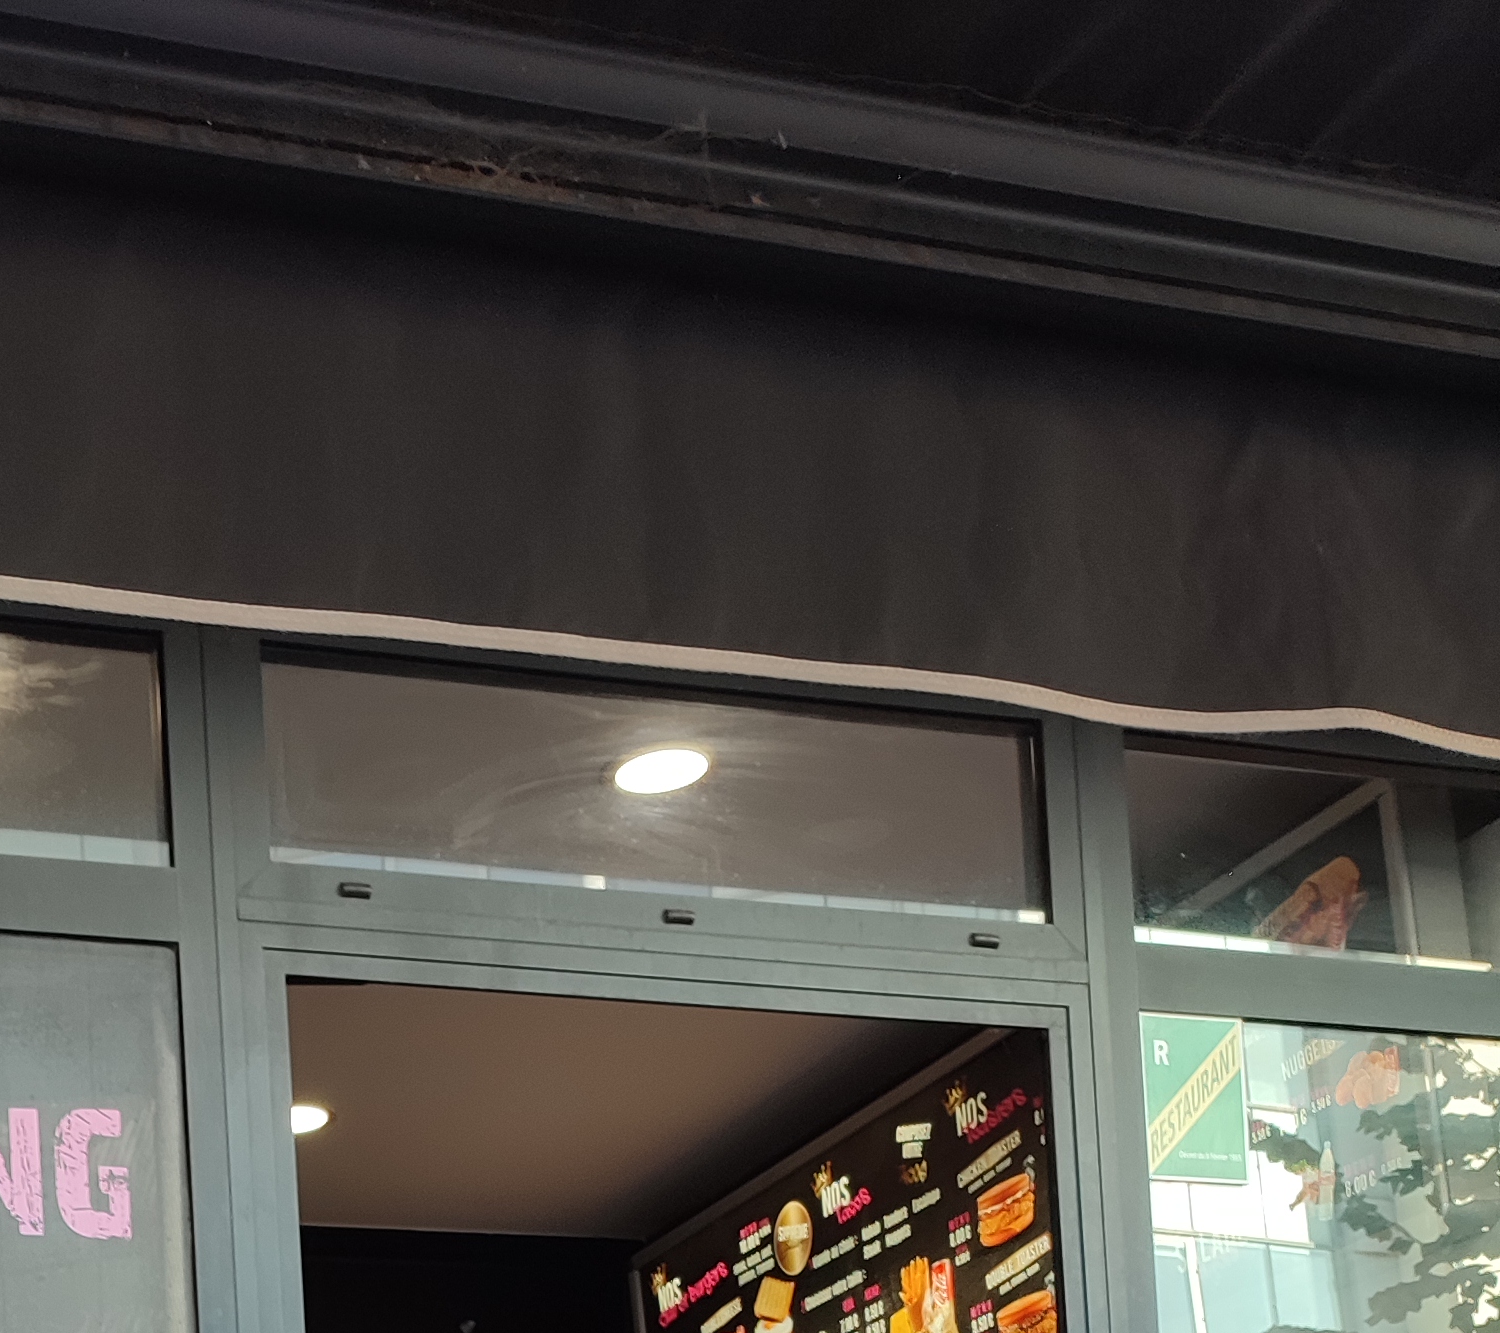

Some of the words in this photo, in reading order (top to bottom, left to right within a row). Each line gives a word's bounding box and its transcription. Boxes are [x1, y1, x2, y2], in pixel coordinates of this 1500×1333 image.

[1153, 1039, 1170, 1066] R
[955, 1090, 988, 1137] NOS
[1150, 1034, 1237, 1164] RESTAURANT
